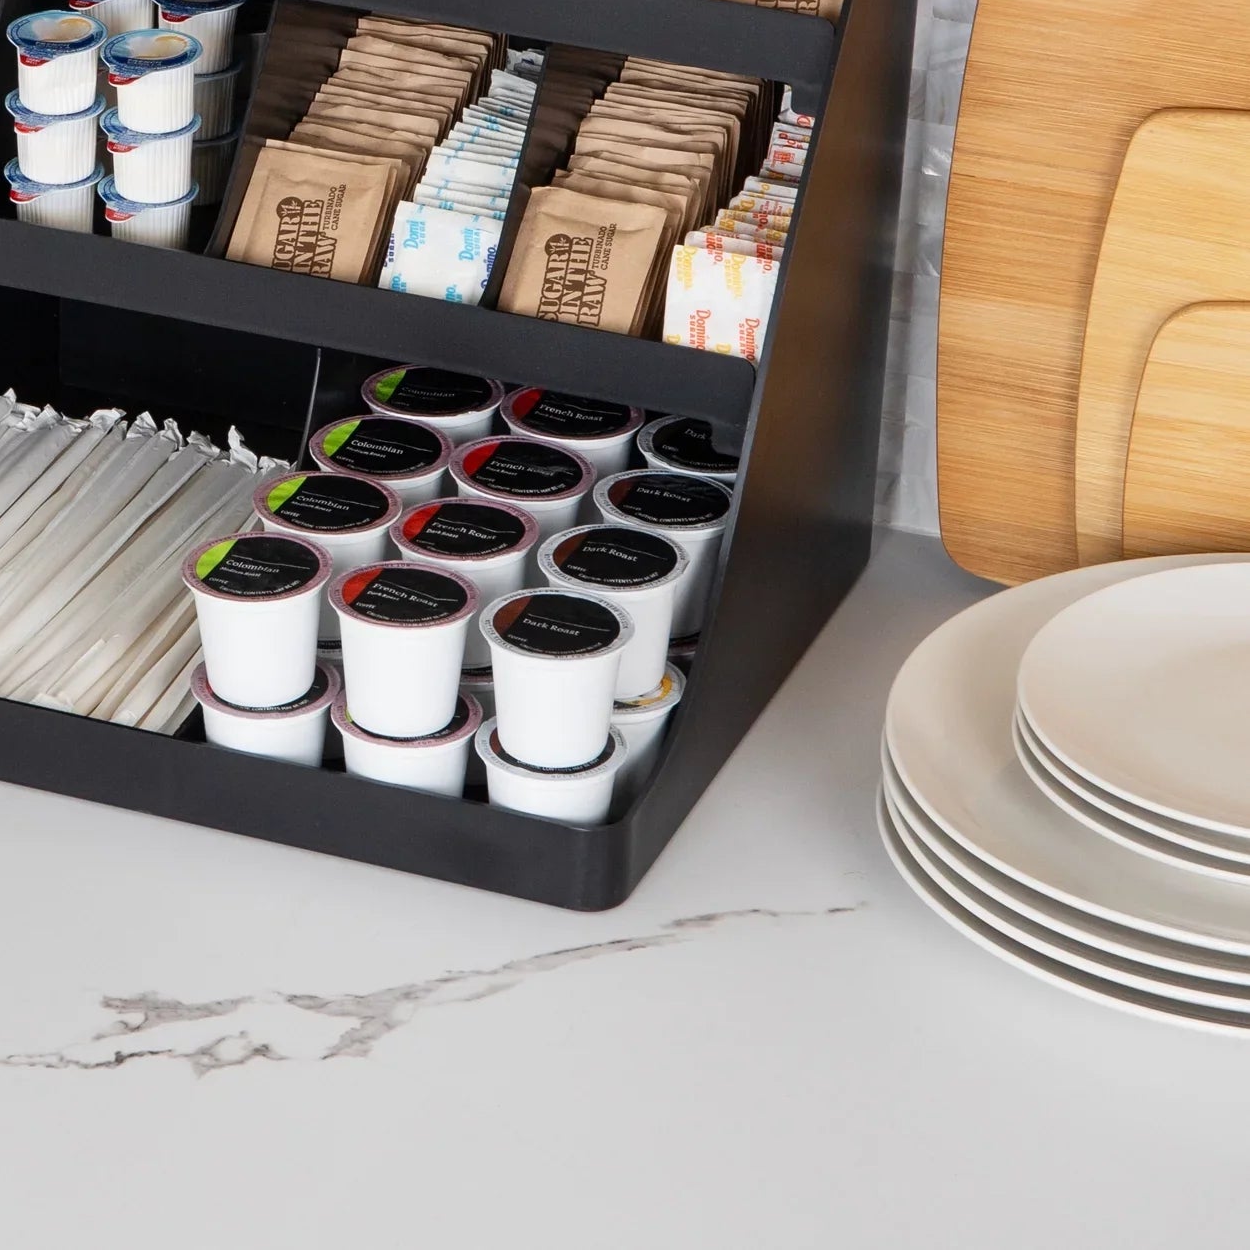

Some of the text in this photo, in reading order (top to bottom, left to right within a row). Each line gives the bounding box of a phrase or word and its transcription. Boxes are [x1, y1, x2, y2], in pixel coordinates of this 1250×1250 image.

[322, 186, 337, 231] TURBINADO
[331, 184, 347, 231] CANE SUGAR
[592, 226, 607, 269] TURBINADO
[600, 223, 617, 271] CANE SUGAR
[745, 318, 760, 361] Domino
[539, 403, 604, 423] French Roast
[684, 428, 707, 440] Dark
[351, 439, 404, 456] Colombian
[369, 450, 387, 459] Roast
[490, 460, 525, 471] French
[296, 495, 350, 511] Colombian
[636, 487, 692, 503] Dark Roast
[426, 528, 459, 539] Dark Roast
[431, 521, 498, 540] French Roast
[582, 545, 638, 563] Dark Roast
[225, 559, 280, 573] Colombian
[208, 576, 229, 584] COFFEE
[366, 590, 400, 601] Dark Roast
[372, 582, 439, 608] French Roast
[522, 617, 581, 636] Dark Roast
